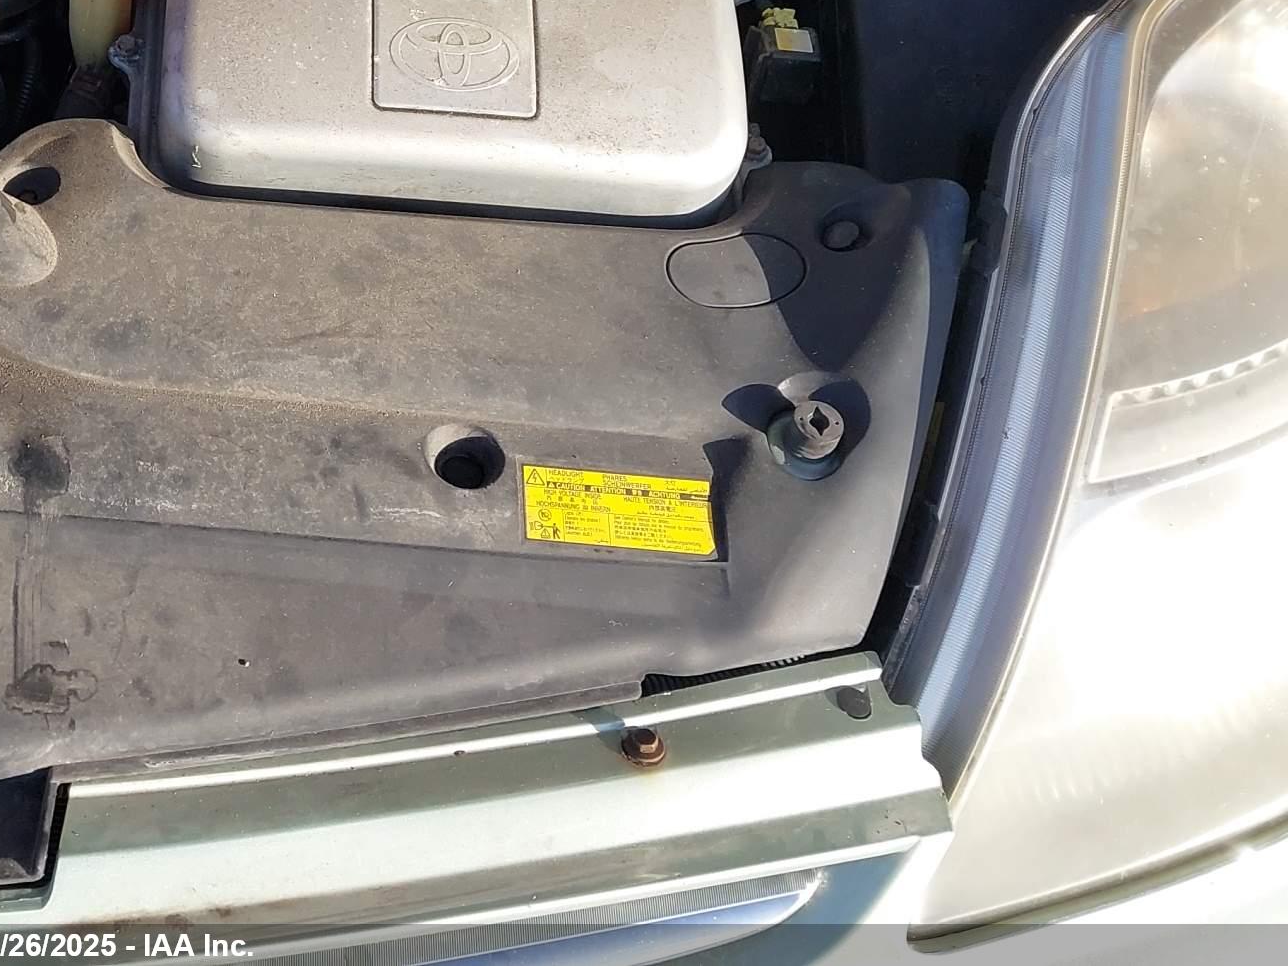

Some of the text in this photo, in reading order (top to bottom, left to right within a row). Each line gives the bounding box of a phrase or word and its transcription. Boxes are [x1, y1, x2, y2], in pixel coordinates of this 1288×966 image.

[549, 469, 585, 478] HEADLIGHT
[556, 482, 586, 491] CAUTION
[590, 486, 627, 496] ATTENTION
[648, 491, 681, 500] ACHTUNG
